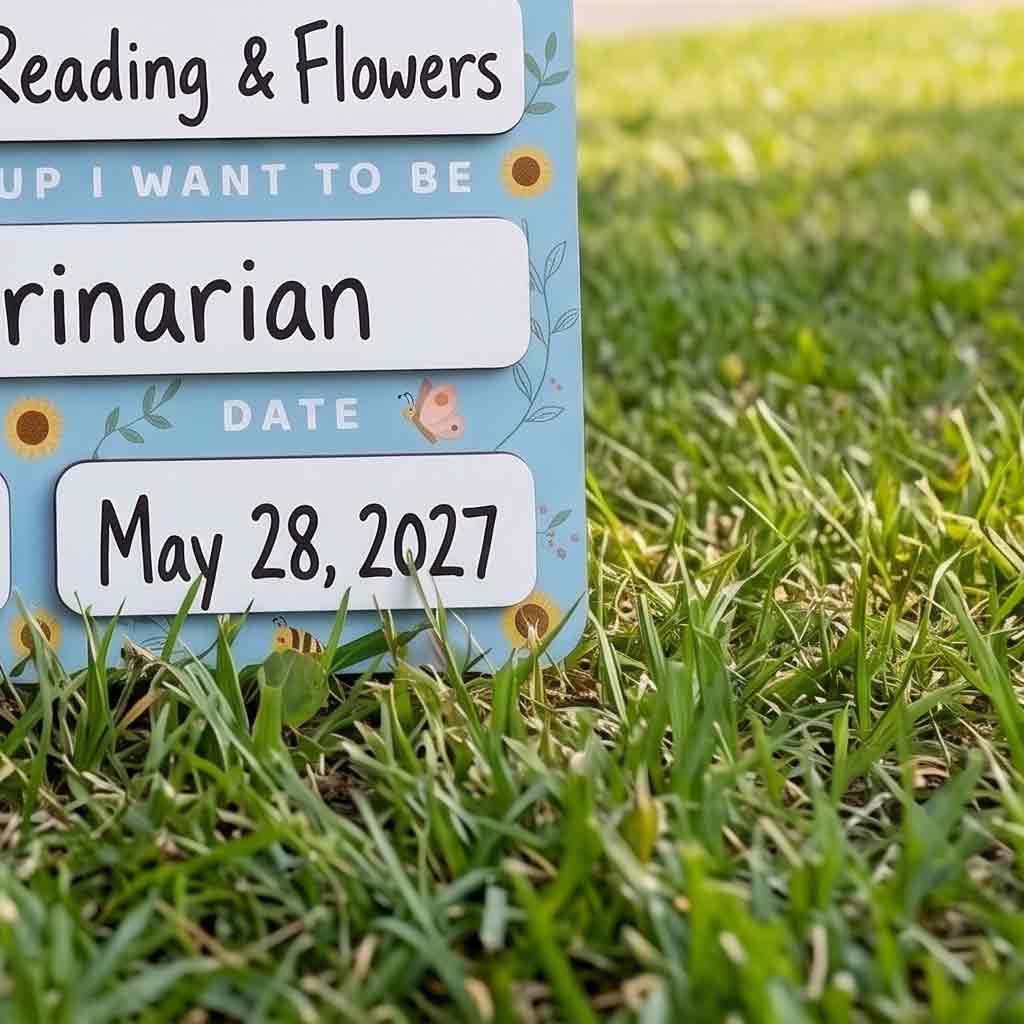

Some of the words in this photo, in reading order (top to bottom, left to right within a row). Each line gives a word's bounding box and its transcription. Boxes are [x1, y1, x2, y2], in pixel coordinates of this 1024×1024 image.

[237, 35, 275, 100] &
[294, 19, 502, 105] Flowers
[92, 166, 103, 198] I
[131, 163, 284, 198] WANT
[315, 161, 381, 194] TO
[410, 160, 471, 194] BE
[223, 398, 358, 432] DATE
[100, 494, 223, 612] May
[251, 503, 336, 589] 28,
[358, 503, 498, 580] 2027
